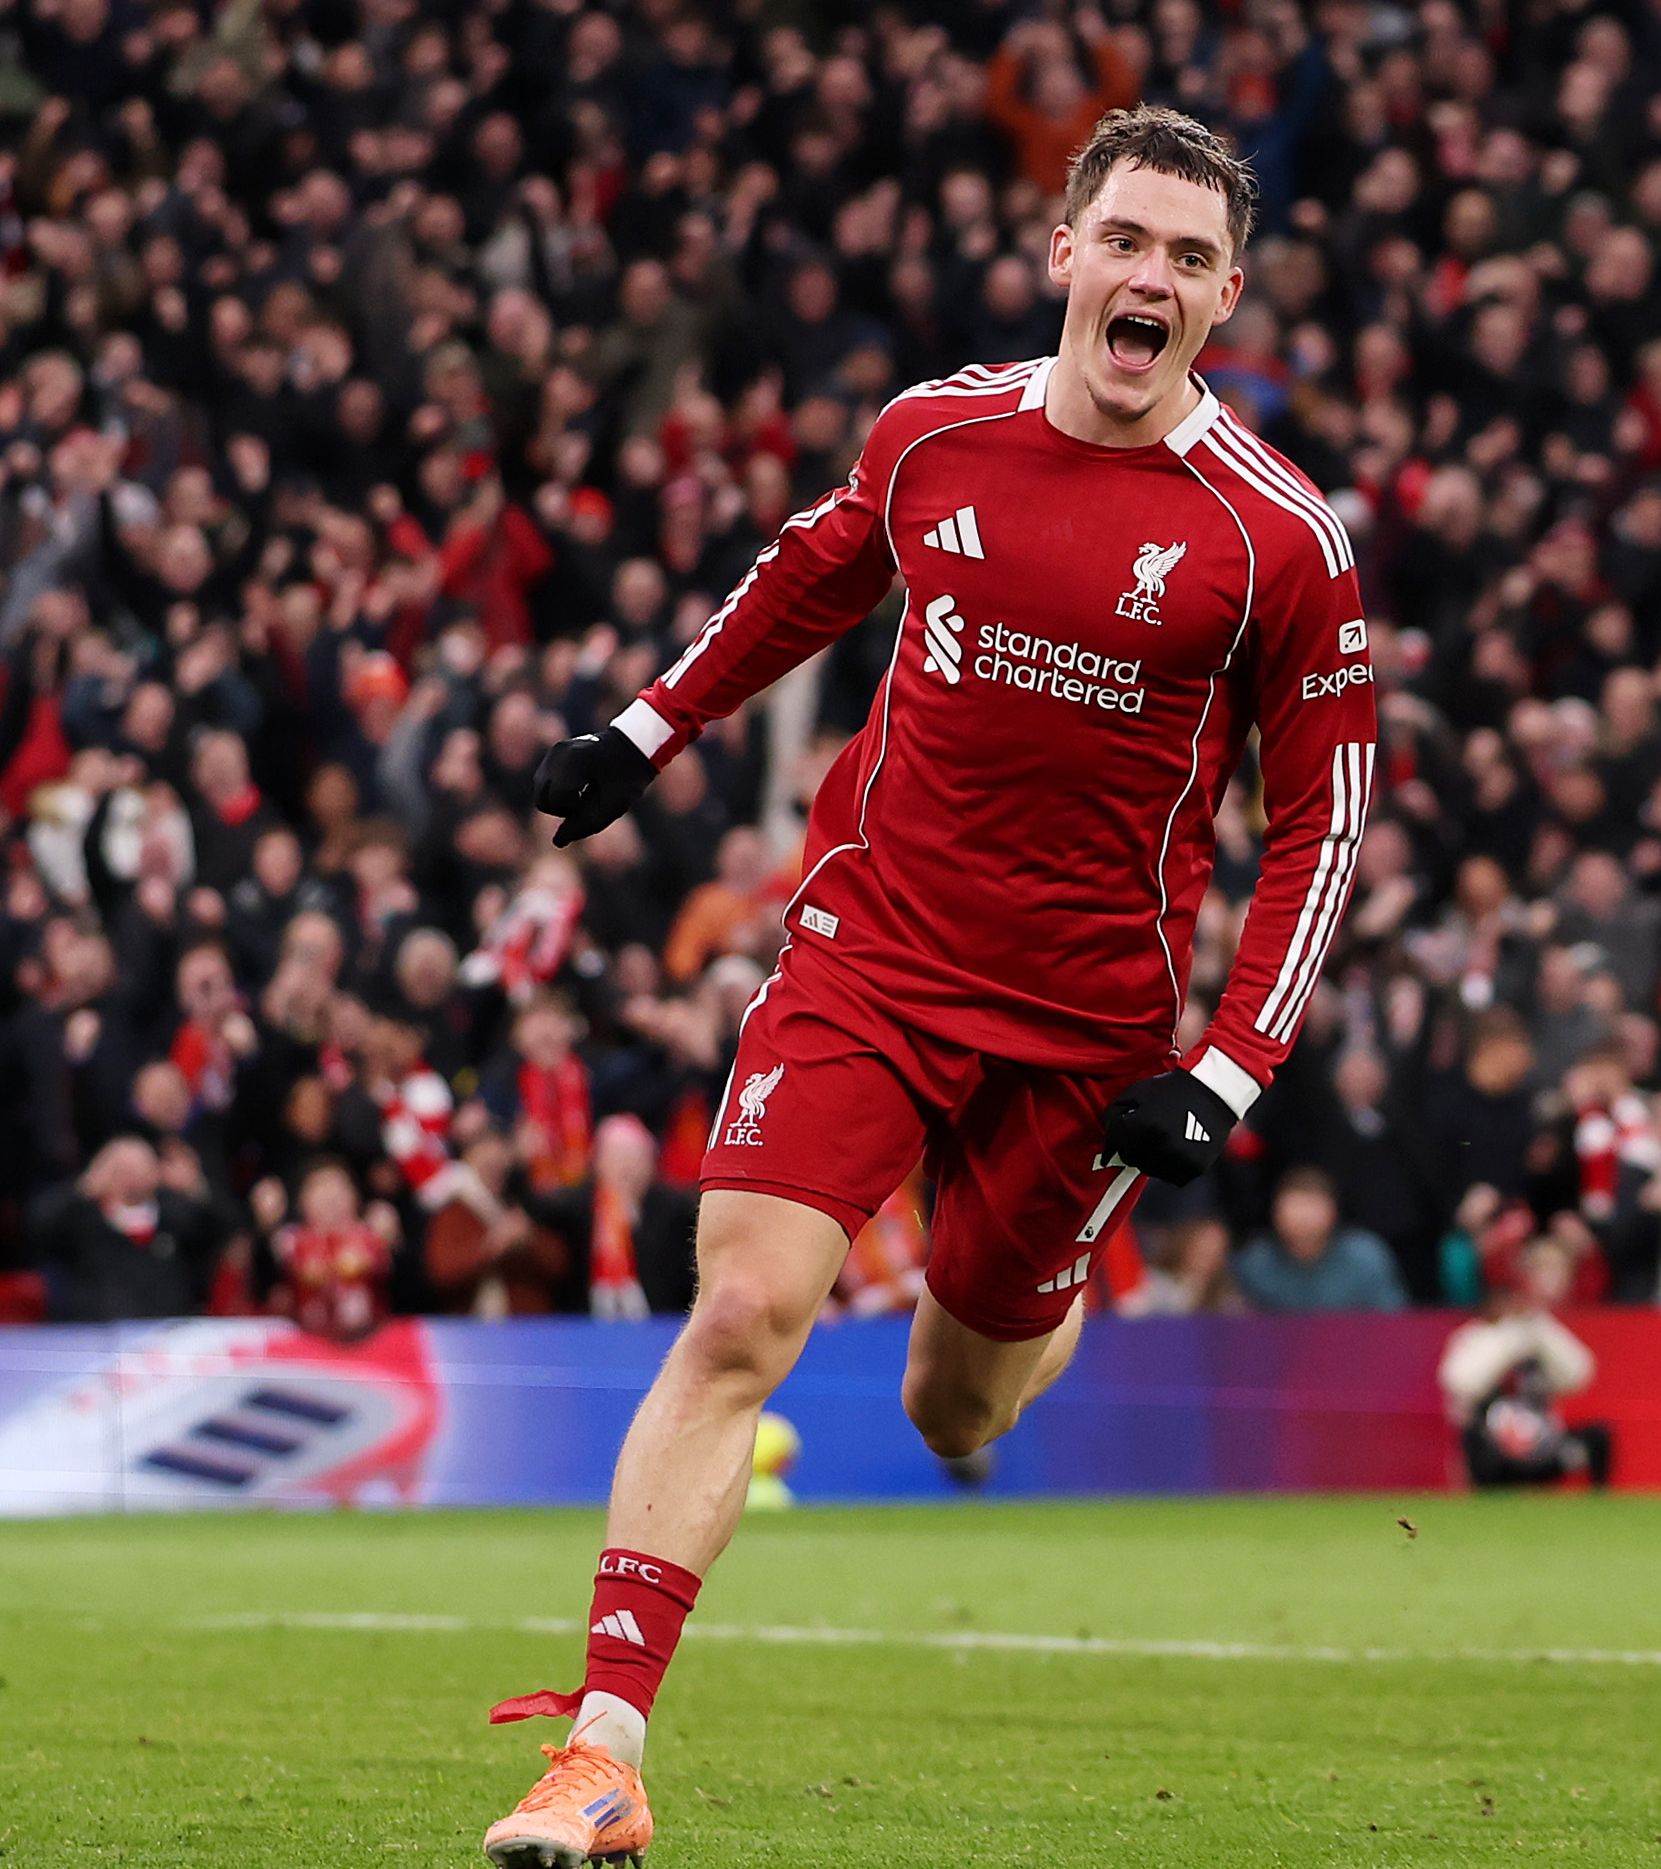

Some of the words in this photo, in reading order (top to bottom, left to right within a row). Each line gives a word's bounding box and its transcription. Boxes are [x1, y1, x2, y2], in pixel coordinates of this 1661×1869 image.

[1115, 597, 1162, 625] L.F.C.
[978, 622, 1141, 684] standard
[974, 653, 1145, 713] chartered
[724, 1128, 763, 1146] L.F.C.
[1075, 1152, 1141, 1242] 7
[600, 1556, 662, 1584] LFC
